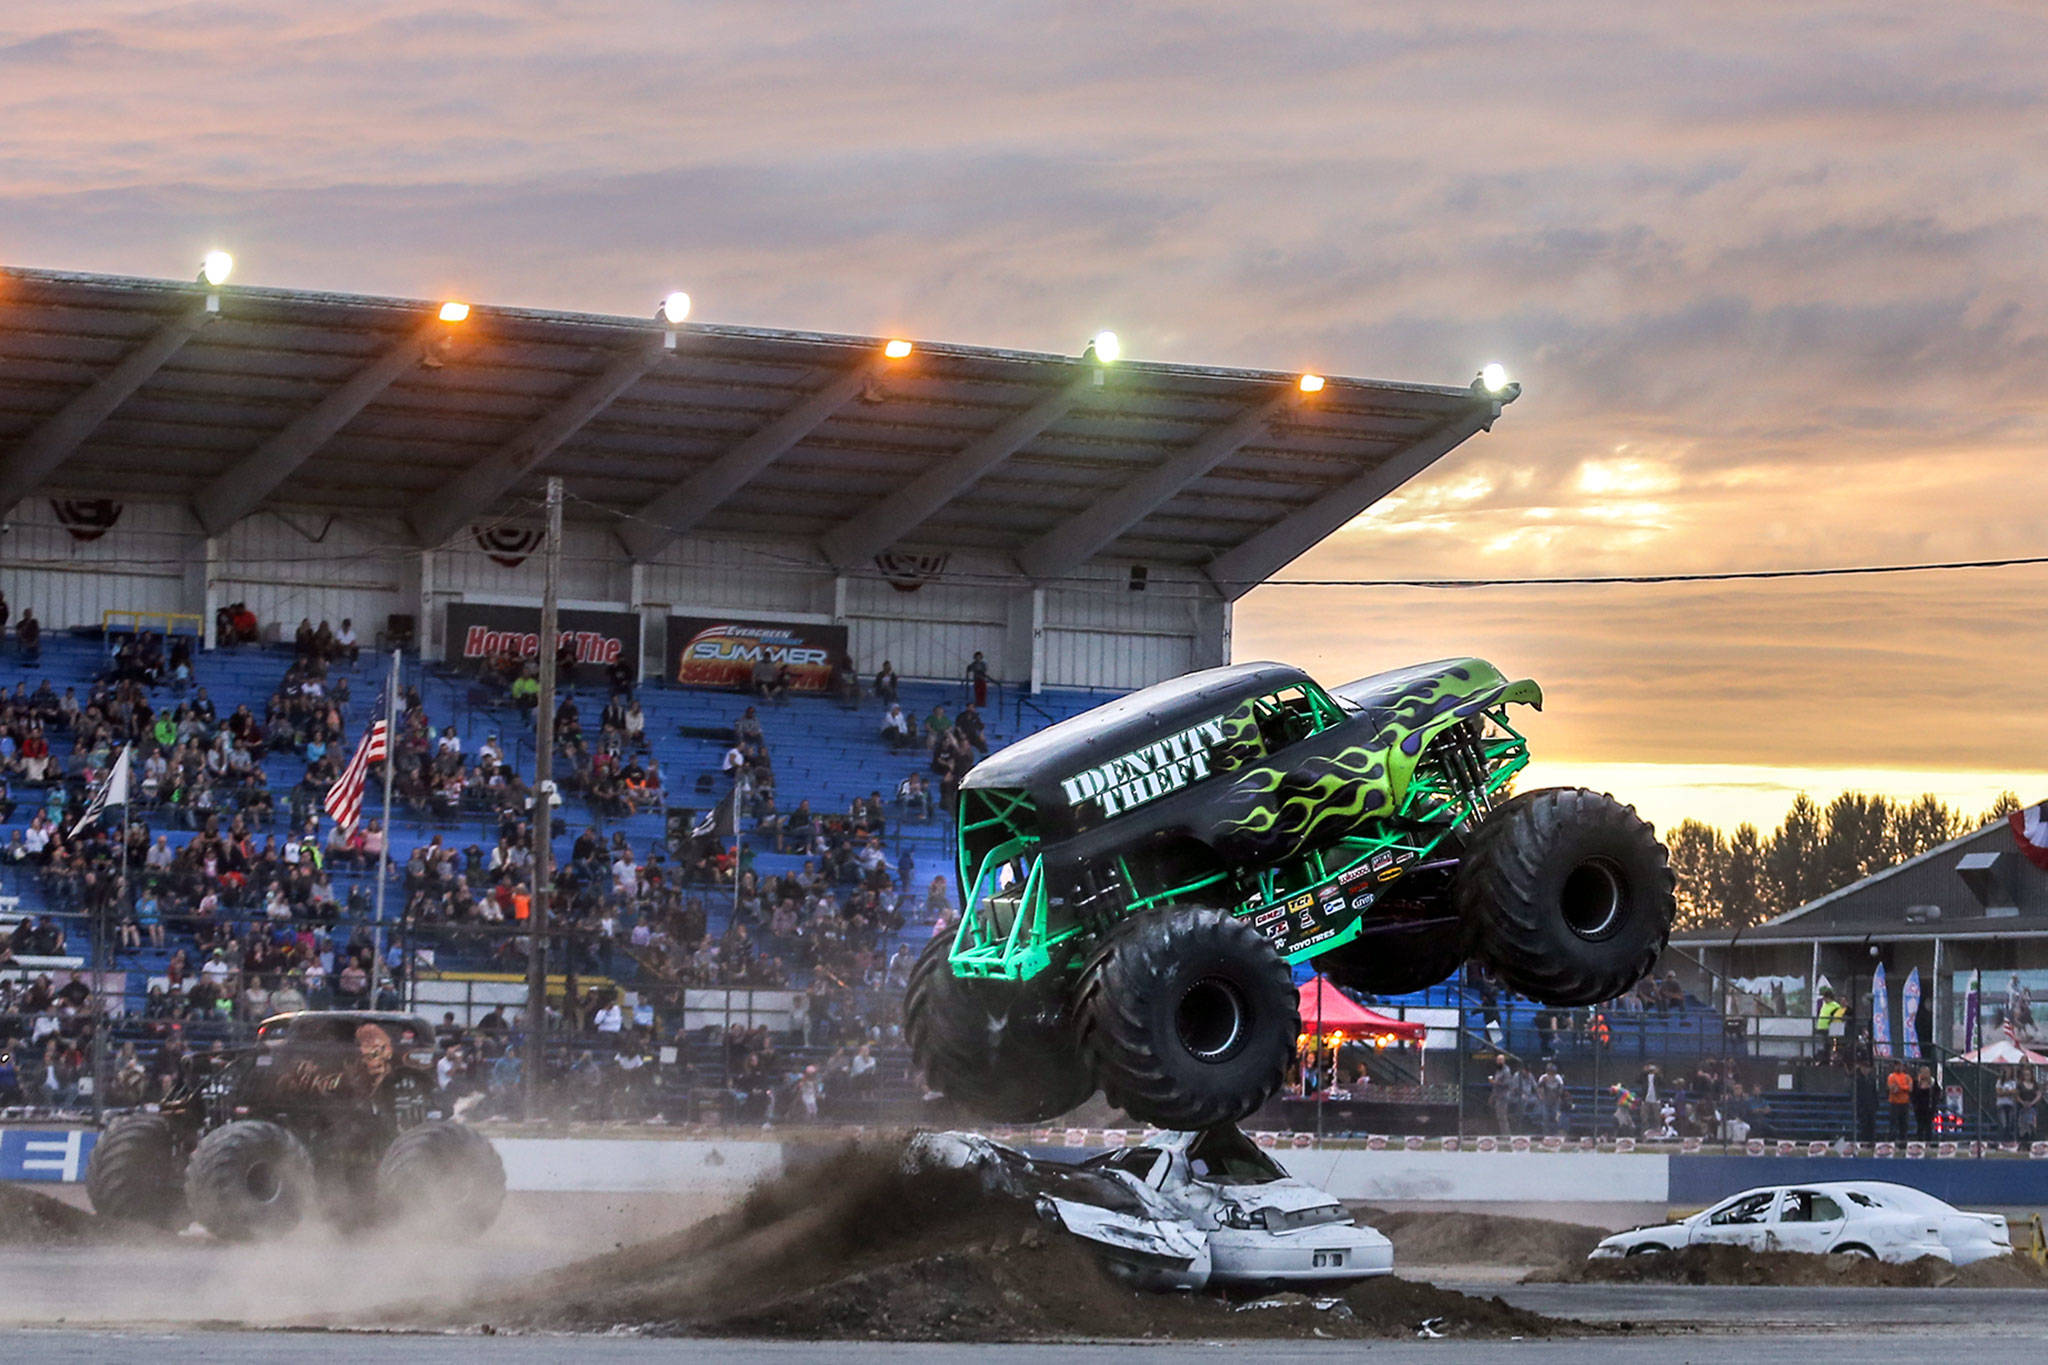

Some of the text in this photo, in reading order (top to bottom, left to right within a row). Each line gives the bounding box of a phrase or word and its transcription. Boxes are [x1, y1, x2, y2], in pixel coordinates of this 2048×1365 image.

[464, 625, 540, 658] Home
[575, 632, 622, 664] The
[693, 643, 828, 666] SUMMER
[1060, 714, 1228, 807] IDENTITY
[1096, 750, 1212, 819] THEFT
[1290, 896, 1310, 910] TCI
[1288, 938, 1312, 953] TOYO
[1311, 928, 1336, 944] TIRES
